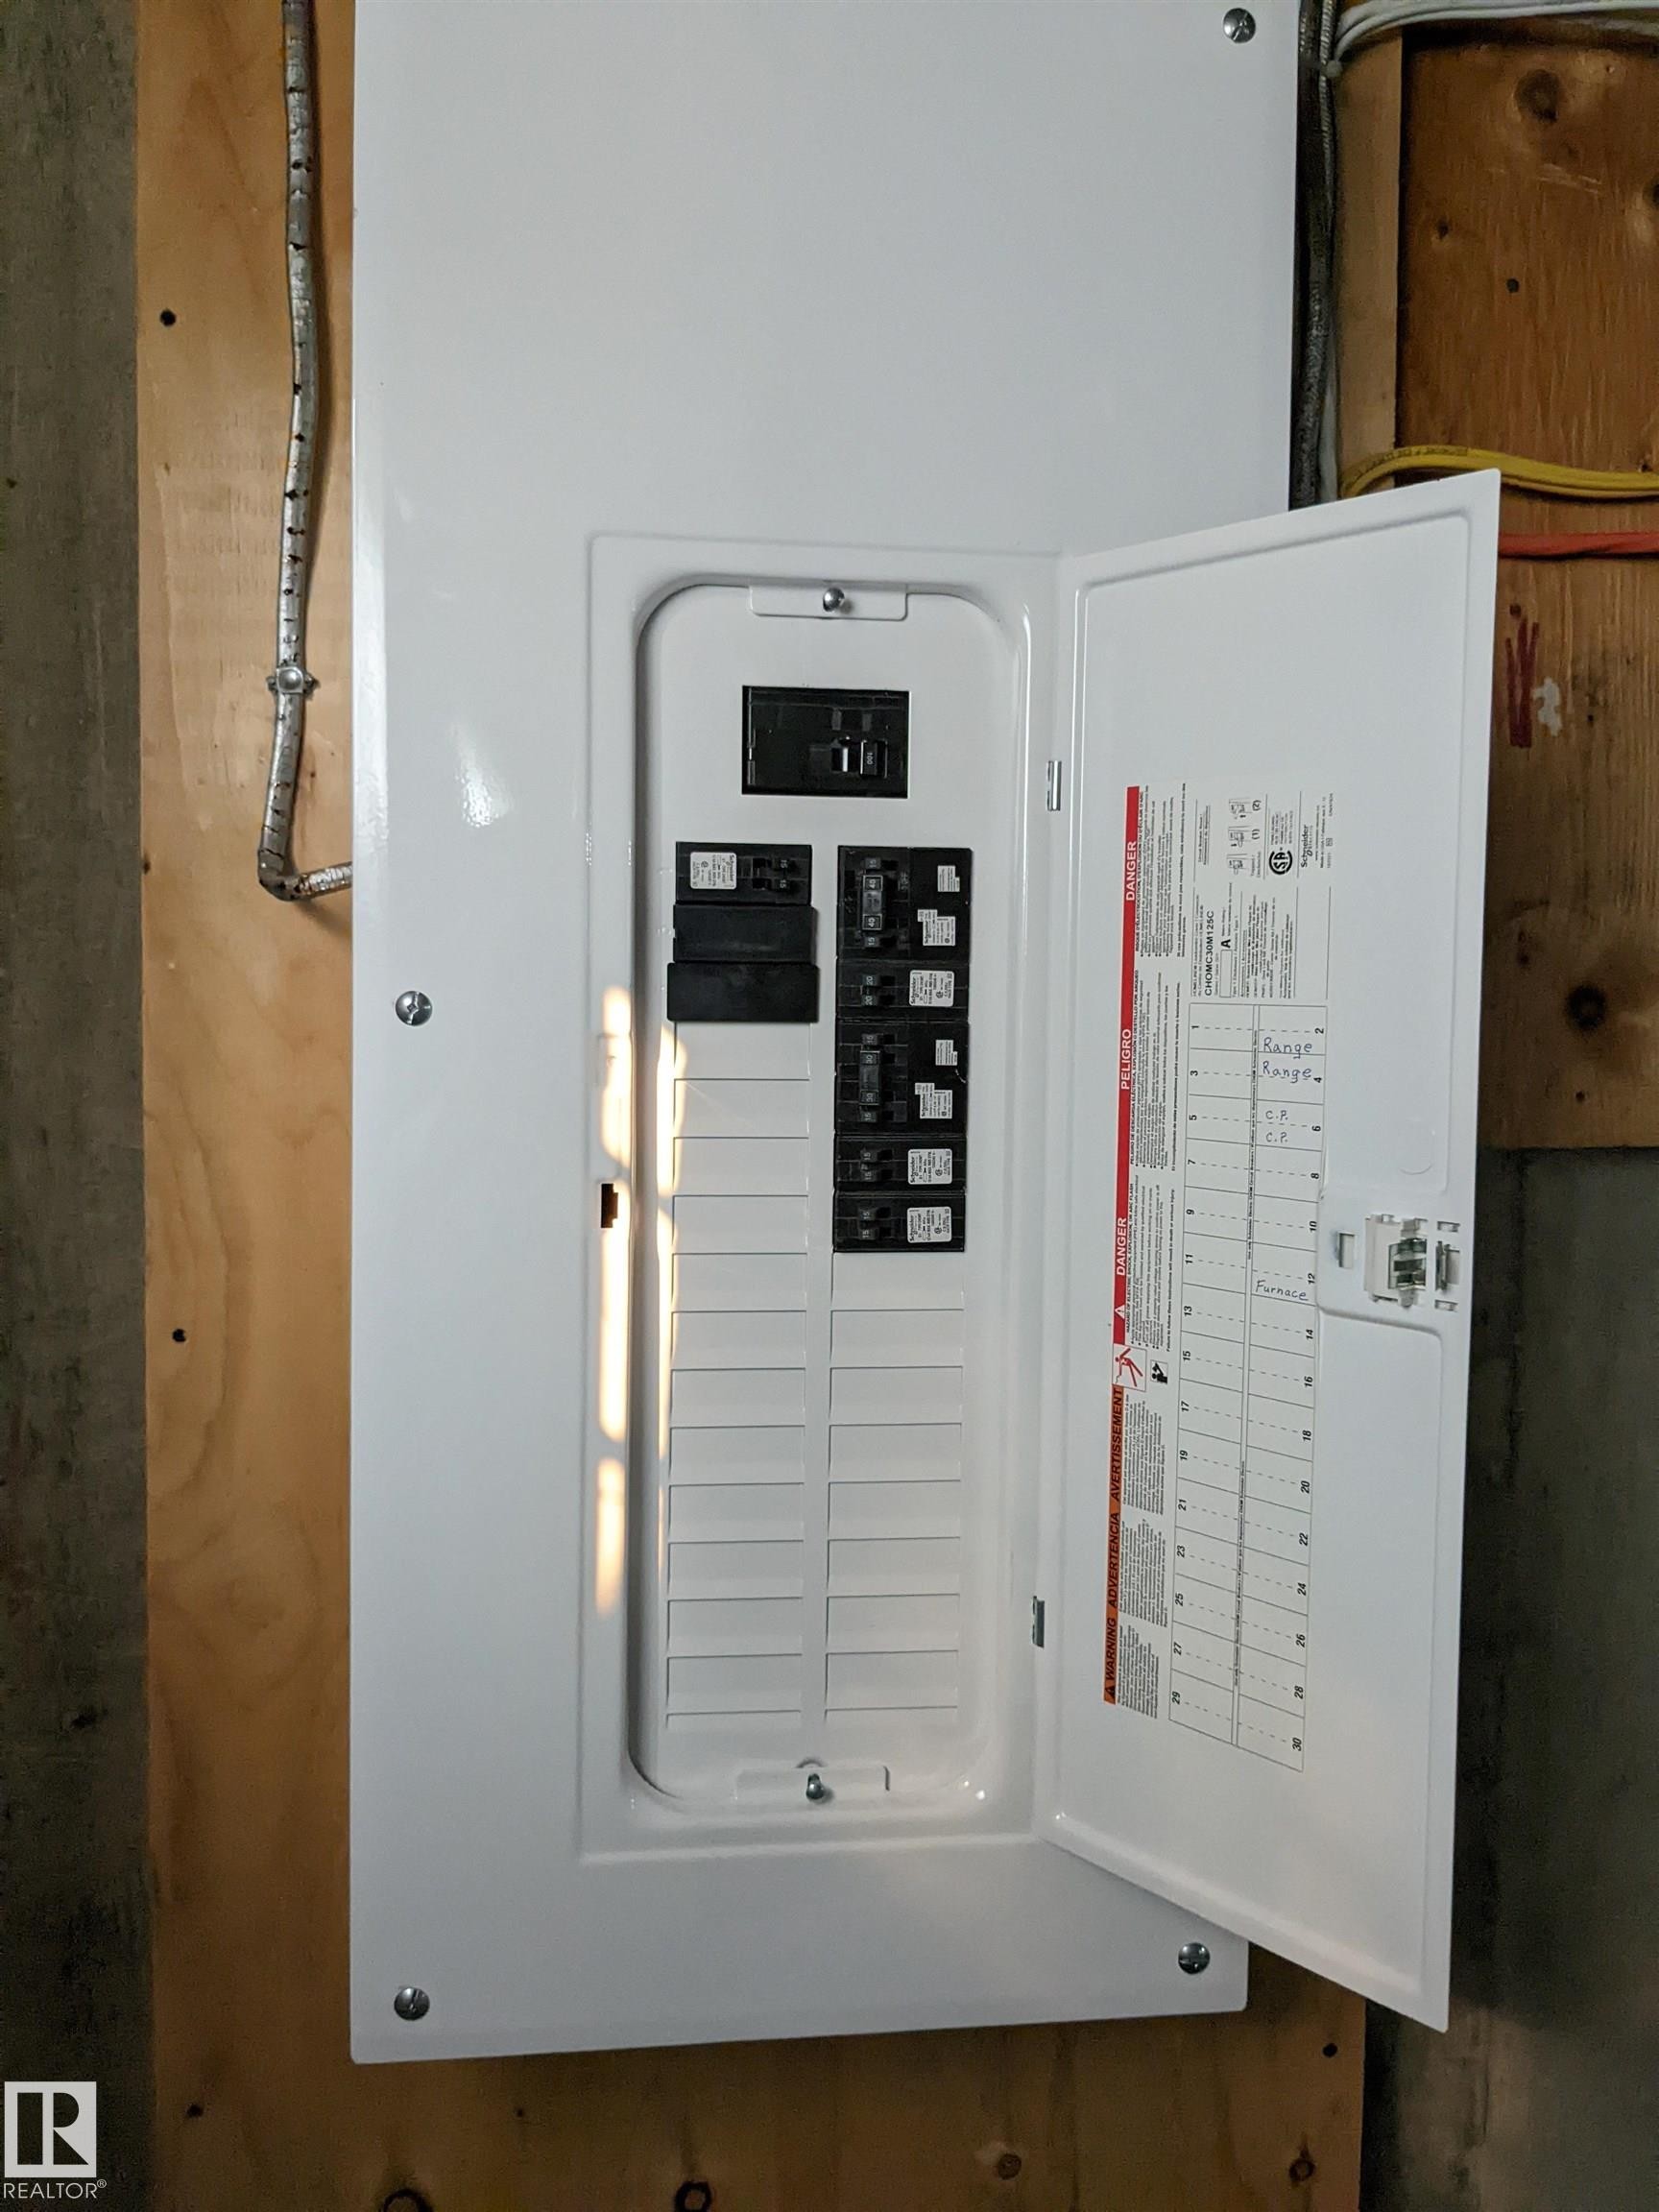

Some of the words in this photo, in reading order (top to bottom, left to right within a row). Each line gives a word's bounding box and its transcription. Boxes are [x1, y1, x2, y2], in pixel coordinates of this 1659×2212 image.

[1252, 800, 1262, 811] (2)
[1251, 829, 1261, 840] (1)
[1300, 825, 1309, 868] Schneider
[1125, 841, 1137, 901] DANGER
[1221, 939, 1231, 949] A
[1204, 910, 1214, 997] CHOMC30M125C
[866, 975, 873, 985] 20
[866, 996, 873, 1005] 20
[1263, 1037, 1312, 1059] Range
[866, 1054, 873, 1064] 30
[1120, 1029, 1131, 1090] PELIGRO
[1262, 1060, 1312, 1084] Range
[866, 1093, 874, 1102] 30
[1310, 1221, 1317, 1232] 10
[1117, 1217, 1126, 1276] DANGER
[1185, 1254, 1193, 1264] 11
[1308, 1273, 1315, 1285] 12
[1256, 1279, 1309, 1301] Furnace
[1184, 1306, 1192, 1316] 13
[1306, 1329, 1313, 1339] 14
[1183, 1351, 1190, 1361] 15
[1304, 1377, 1312, 1387] 16
[1181, 1401, 1190, 1412] 17
[1302, 1430, 1311, 1441] 18
[1111, 1387, 1121, 1502] AVERTISSEMENT
[1180, 1450, 1189, 1461] 19
[1300, 1480, 1310, 1494] 20
[1178, 1499, 1187, 1511] 21
[1299, 1532, 1309, 1547] 22
[1177, 1545, 1185, 1558] 23
[1108, 1512, 1118, 1609] ADVERTENCIA
[1297, 1583, 1307, 1596] 24
[1175, 1593, 1184, 1606] 25
[1296, 1634, 1306, 1647] 26
[1105, 1618, 1116, 1681] WARNING
[1173, 1642, 1182, 1655] 27
[1172, 1691, 1181, 1705] 29
[1294, 1686, 1304, 1699] 28
[1292, 1738, 1302, 1751] 30
